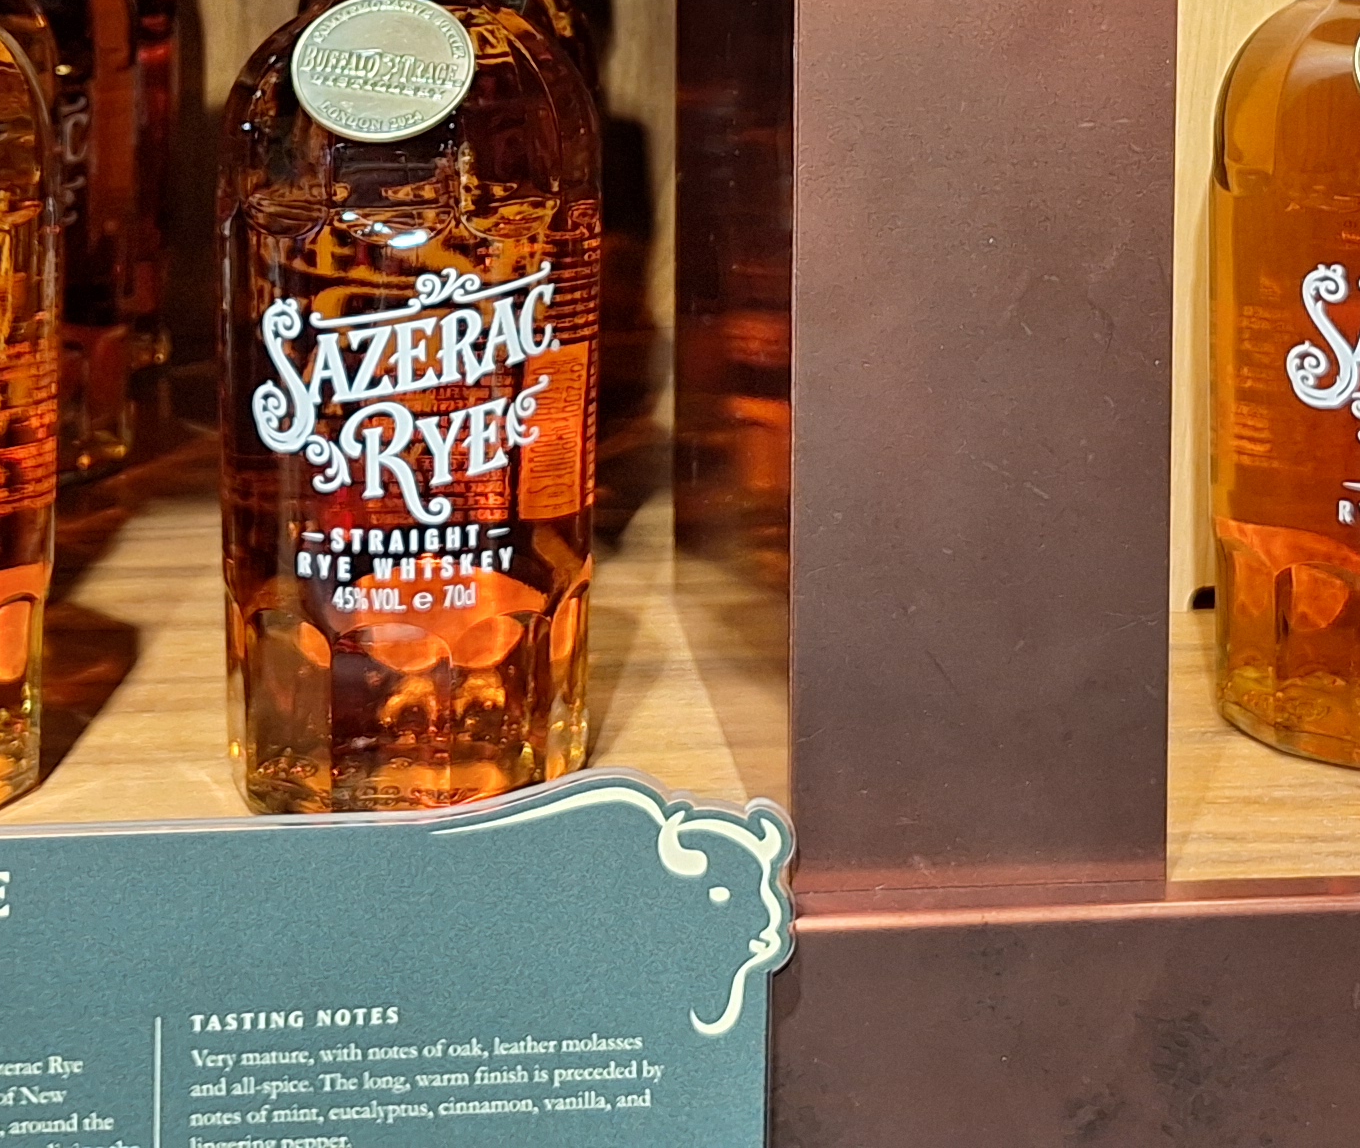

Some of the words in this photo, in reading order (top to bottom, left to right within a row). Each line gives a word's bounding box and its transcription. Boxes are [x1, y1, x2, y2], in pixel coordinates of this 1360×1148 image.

[300, 46, 380, 78] BUFFALO
[398, 54, 459, 88] TRACE
[319, 100, 383, 131] LONDON
[253, 283, 556, 451] SAZERAC
[337, 397, 512, 523] RYE
[330, 525, 480, 554] STRAIGHT
[296, 552, 352, 581] RYE
[373, 547, 513, 582] WHISKEY
[332, 586, 368, 612] 45%
[370, 588, 407, 613] VOL
[190, 1010, 304, 1032] TASTING
[316, 1007, 399, 1027] NOTES
[47, 1056, 84, 1079] Rye
[190, 1049, 236, 1072] Very
[241, 1050, 315, 1066] mature,
[319, 1043, 362, 1061] with
[367, 1045, 418, 1060] notes
[422, 1038, 447, 1057] of
[448, 1037, 489, 1058] oak,
[493, 1034, 557, 1055] leather
[561, 1032, 644, 1052] molasses
[18, 1085, 68, 1104] New
[189, 1077, 227, 1097] and
[231, 1075, 314, 1099] all-spice.
[318, 1073, 358, 1092] The
[363, 1070, 411, 1093] long,
[415, 1073, 469, 1087] warm
[474, 1065, 528, 1085] finish
[533, 1064, 549, 1083] is
[553, 1060, 637, 1088] preceded
[642, 1059, 664, 1084] by
[9, 1113, 78, 1135] around
[82, 1111, 115, 1131] the
[189, 1109, 241, 1127] notes
[246, 1105, 271, 1124] of
[272, 1104, 324, 1125] mint,
[328, 1100, 434, 1124] eucalyptus,
[438, 1097, 539, 1115] cinnamon,
[544, 1090, 612, 1112] vanilla,
[615, 1088, 651, 1108] and
